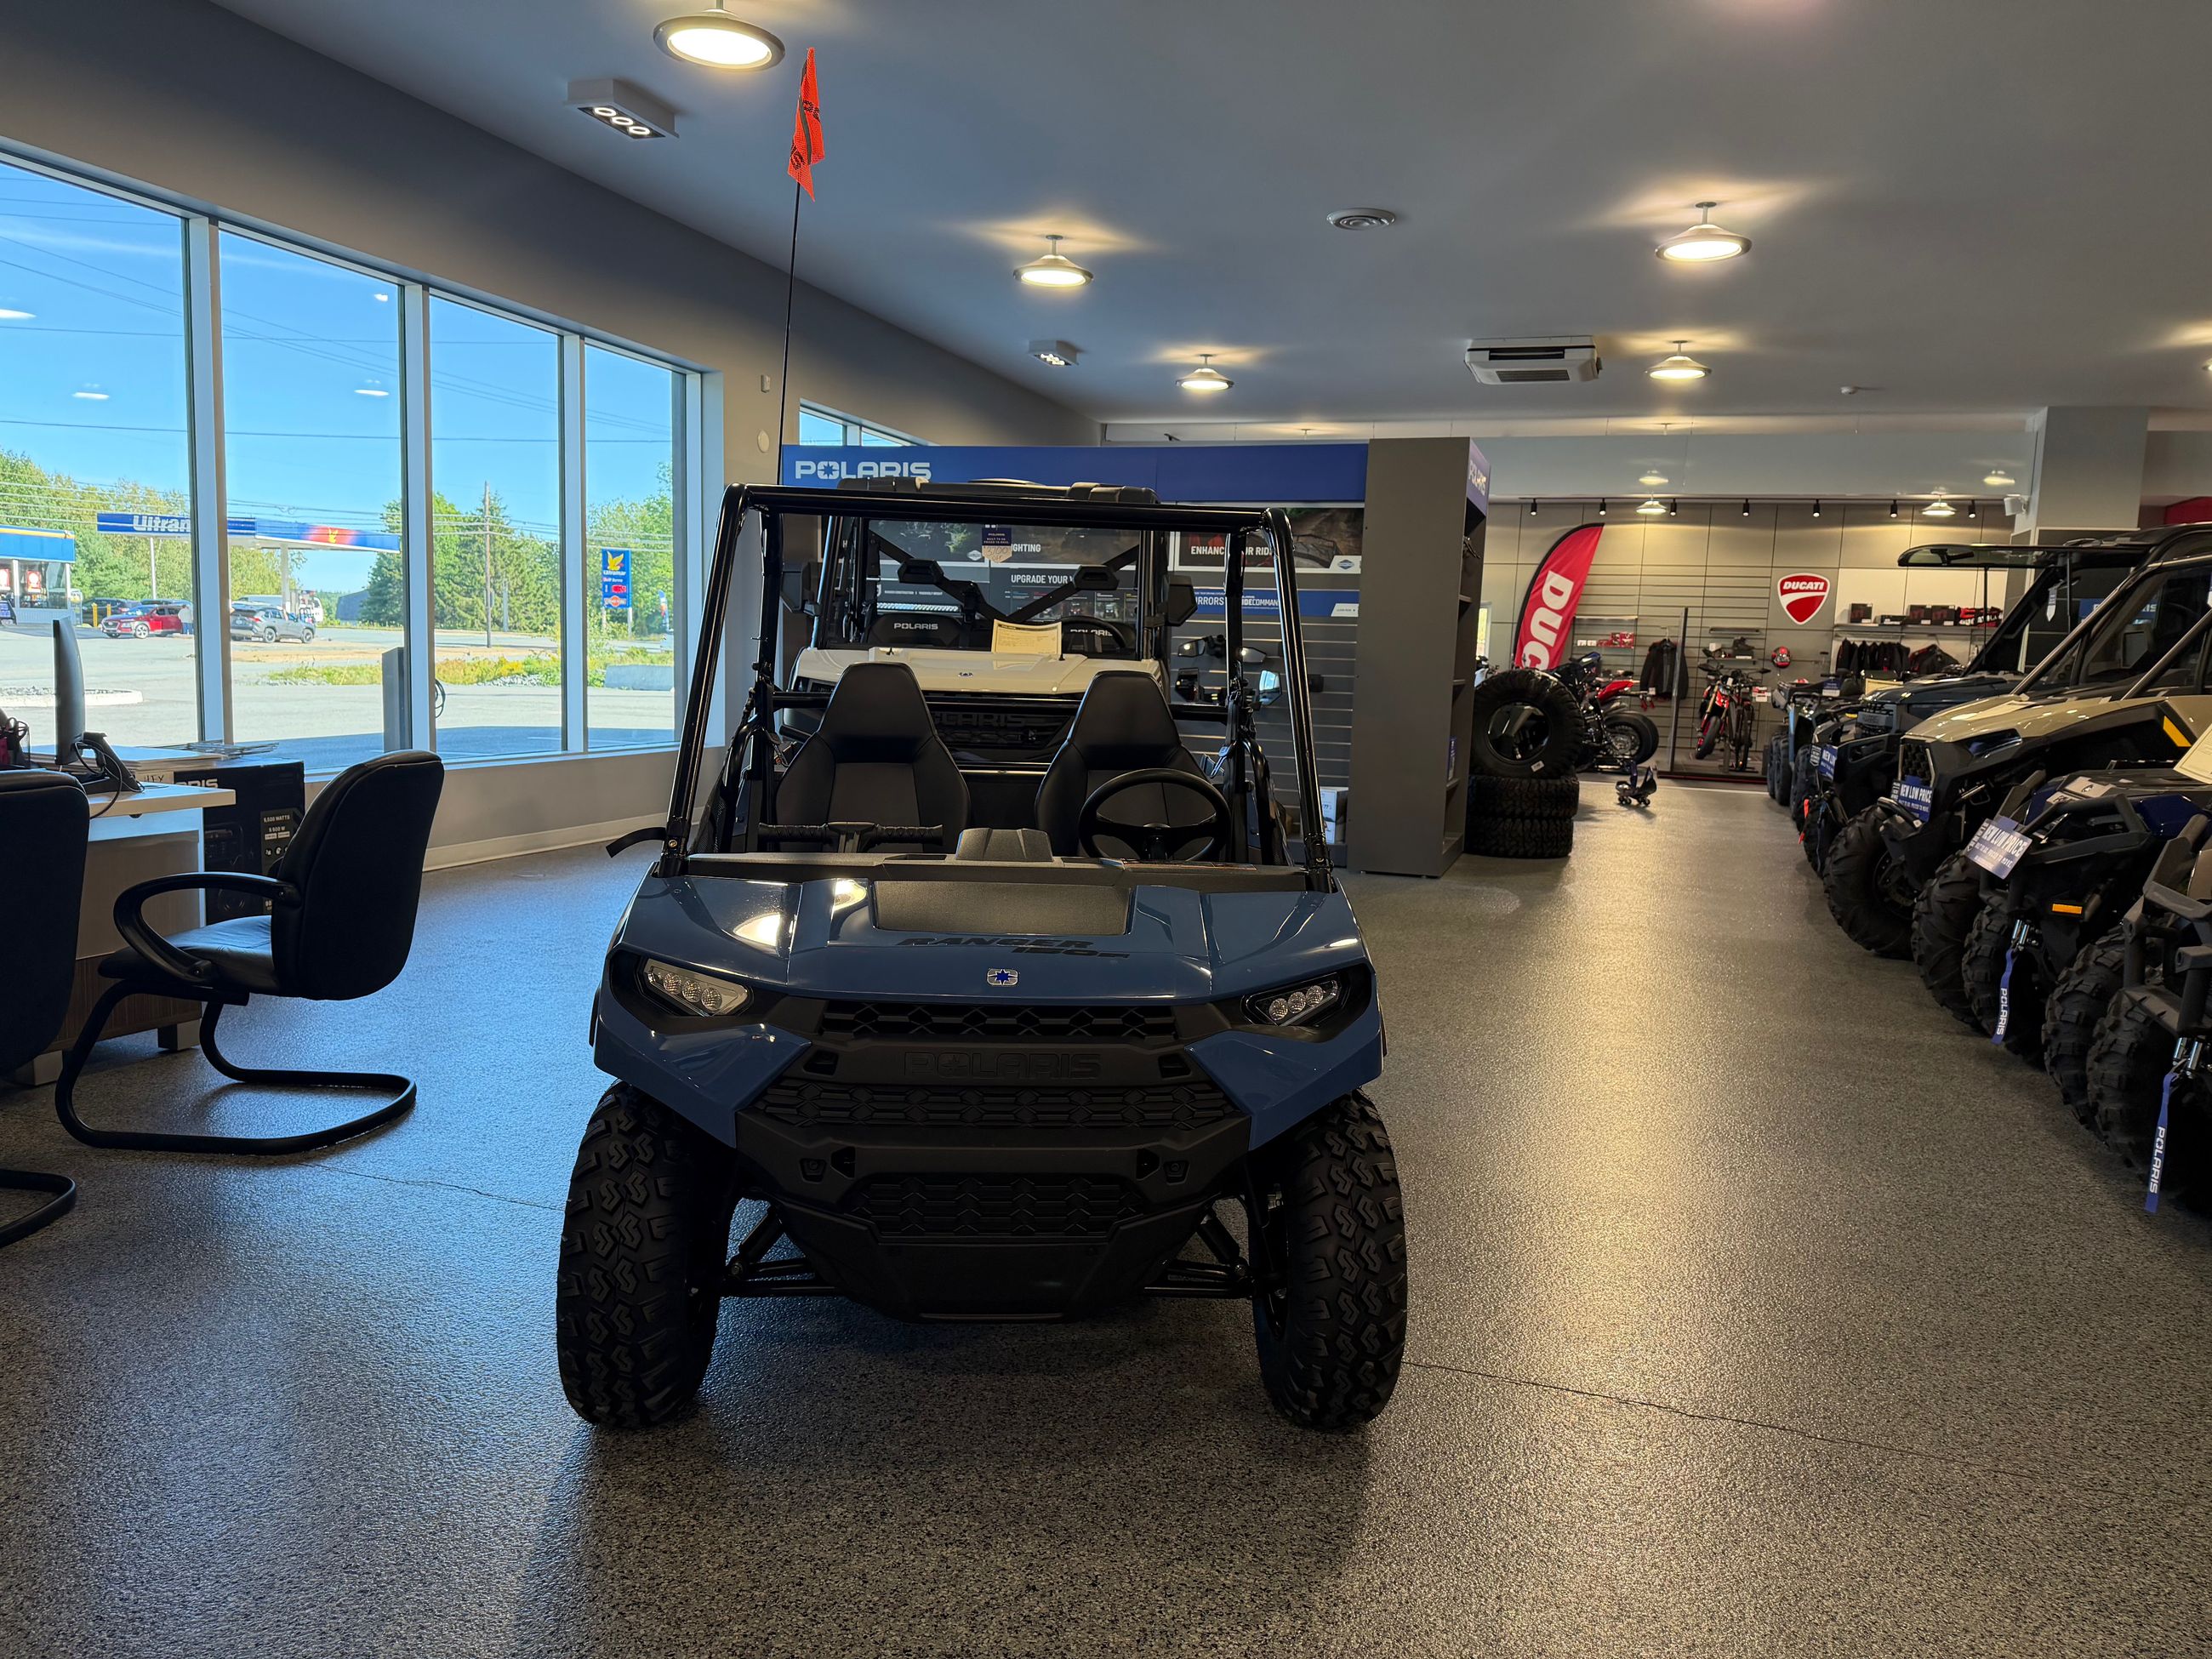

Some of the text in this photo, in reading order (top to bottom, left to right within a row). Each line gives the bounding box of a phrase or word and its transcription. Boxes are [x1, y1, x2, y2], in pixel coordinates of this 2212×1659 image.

[795, 460, 932, 481] POLARIS
[1010, 544, 1041, 553] IGHTING
[1190, 546, 1225, 555] ENHANC
[1255, 547, 1272, 556] RID
[1011, 574, 1046, 584] UPGRADE
[1047, 575, 1069, 584] YOUR
[1782, 581, 1825, 590] DUCATI
[1195, 596, 1225, 605] IRRORS
[1521, 570, 1575, 671] DUC
[1981, 824, 1998, 841] NEW
[1991, 829, 2010, 847] LOW
[2001, 835, 2027, 857] PRICE
[896, 938, 1094, 949] RANGER
[1996, 988, 2008, 1036] POLARIS
[904, 1052, 1103, 1079] POLARIS
[2149, 1126, 2166, 1194] POLARIS
